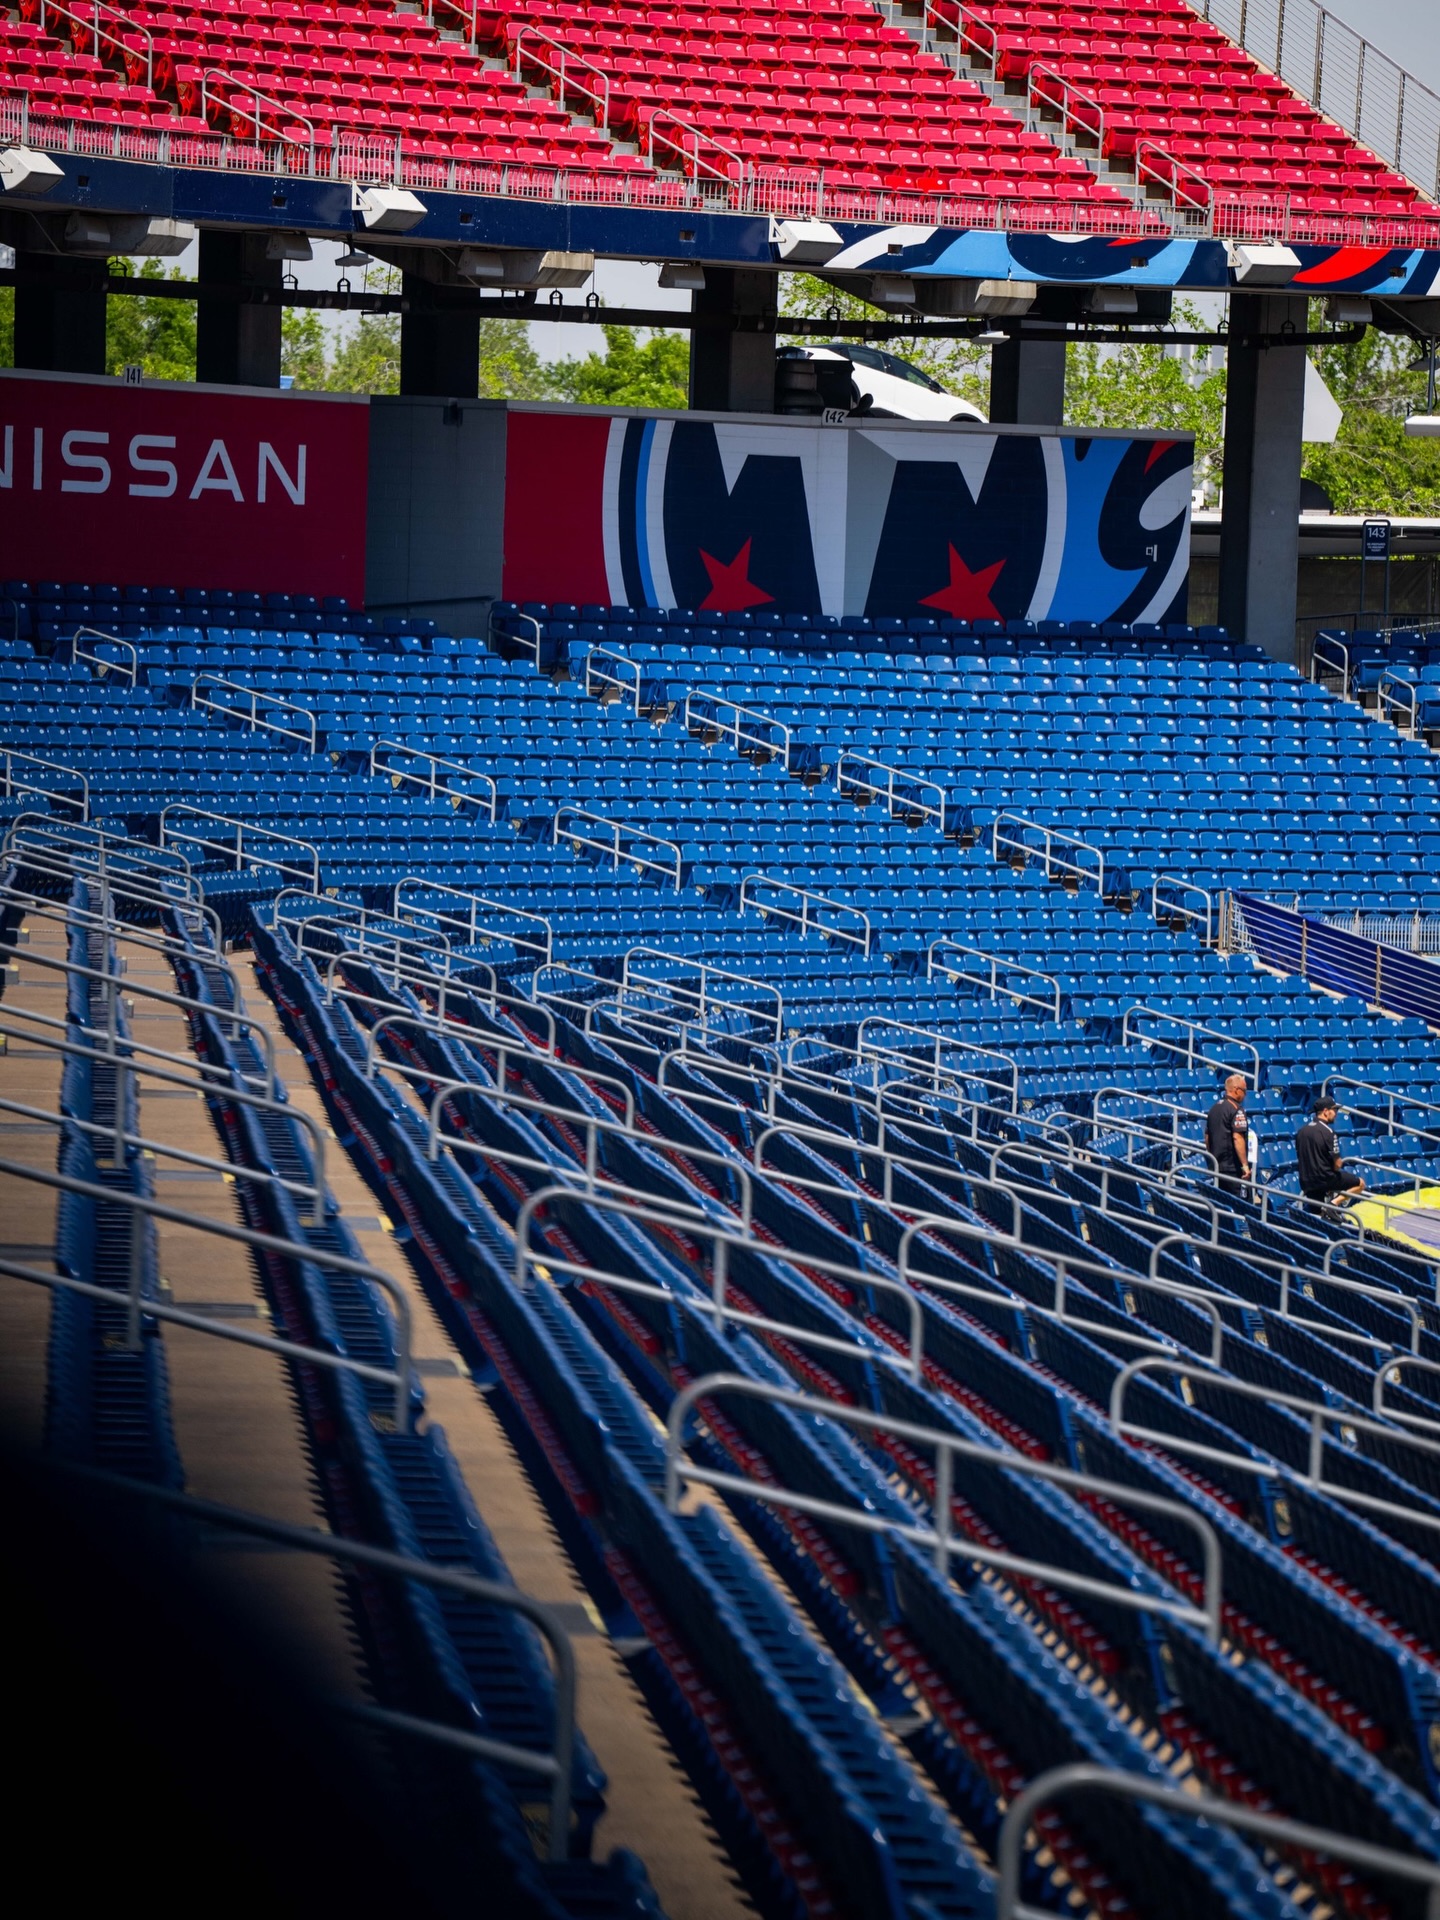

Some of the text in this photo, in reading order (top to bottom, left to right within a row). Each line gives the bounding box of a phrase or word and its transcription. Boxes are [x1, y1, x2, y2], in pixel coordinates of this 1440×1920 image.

[126, 367, 141, 384] 141
[825, 410, 845, 423] 142
[0, 425, 307, 505] ISSAN
[1367, 527, 1386, 538] 143
